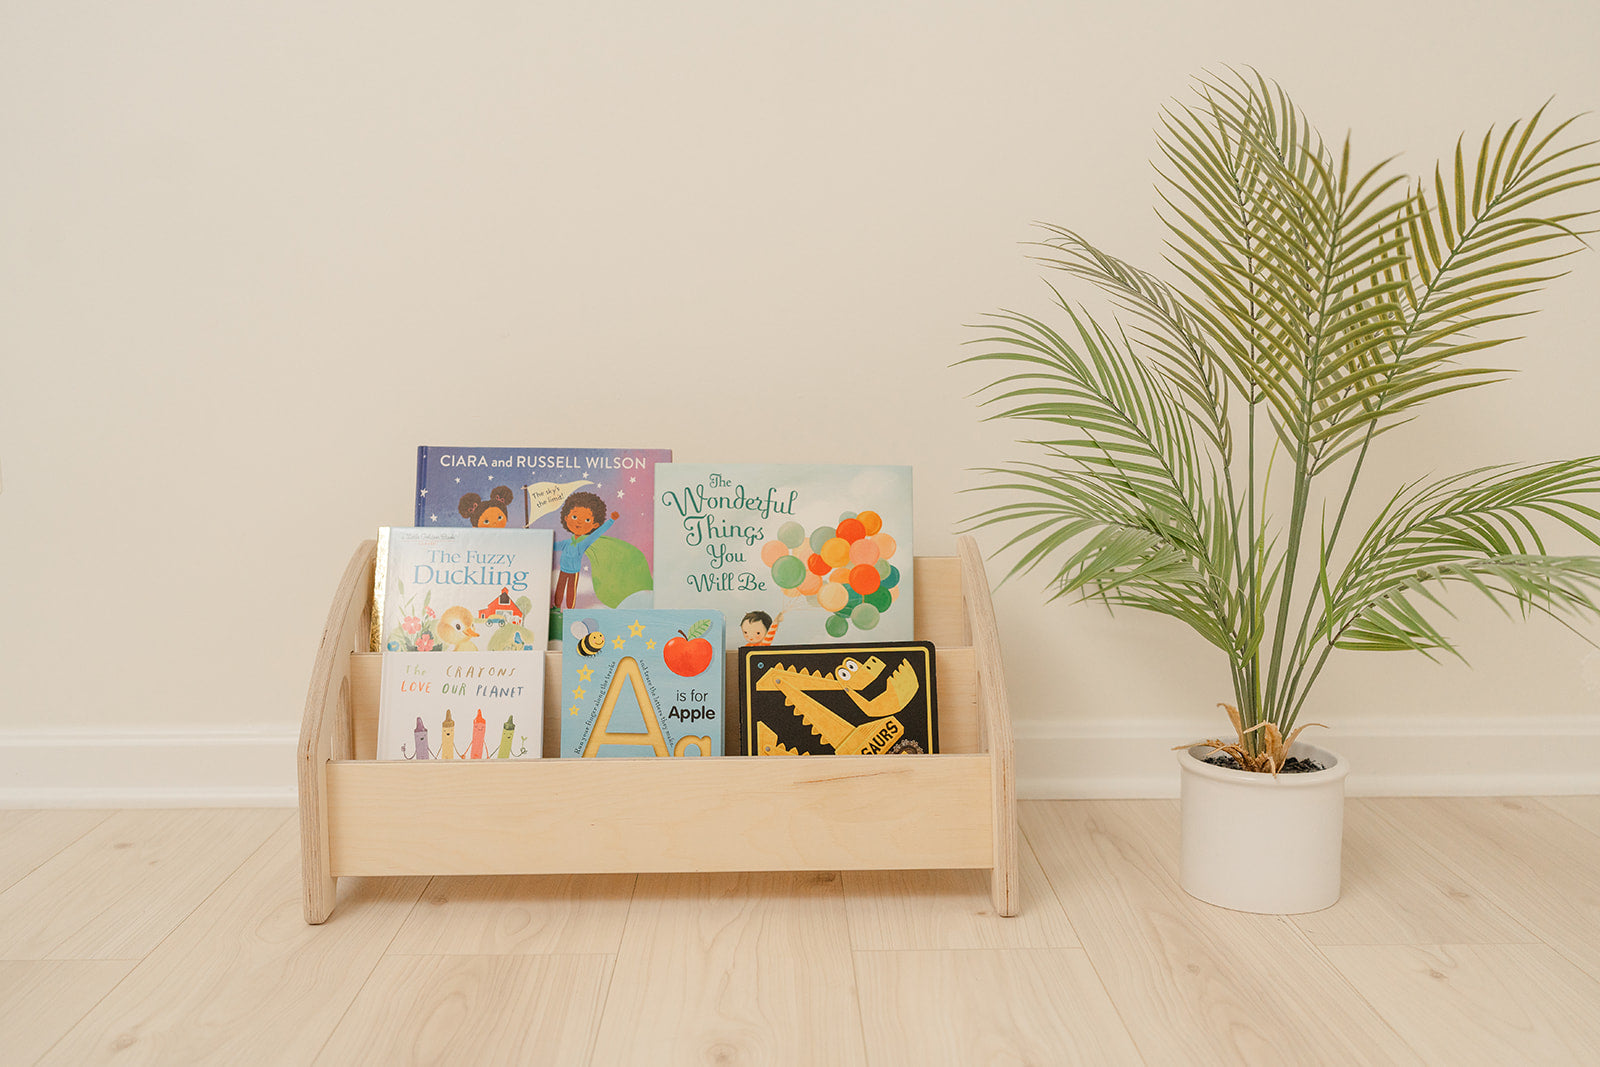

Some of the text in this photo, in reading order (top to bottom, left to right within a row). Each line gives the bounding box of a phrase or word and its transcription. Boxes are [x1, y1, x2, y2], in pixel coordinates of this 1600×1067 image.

[440, 454, 647, 470] CIARA and RUSSELL WILSON
[708, 473, 732, 488] The
[661, 483, 799, 520] Wonderful
[683, 513, 765, 547] Things
[428, 550, 516, 568] The Fuzzy
[706, 543, 747, 570] You
[412, 564, 530, 592] Duckling
[686, 572, 768, 593] Will Be
[446, 665, 516, 678] CRAYONS
[400, 680, 524, 699] LOVE OUR PLANET
[676, 688, 709, 702] is for
[668, 705, 716, 723] Apple
